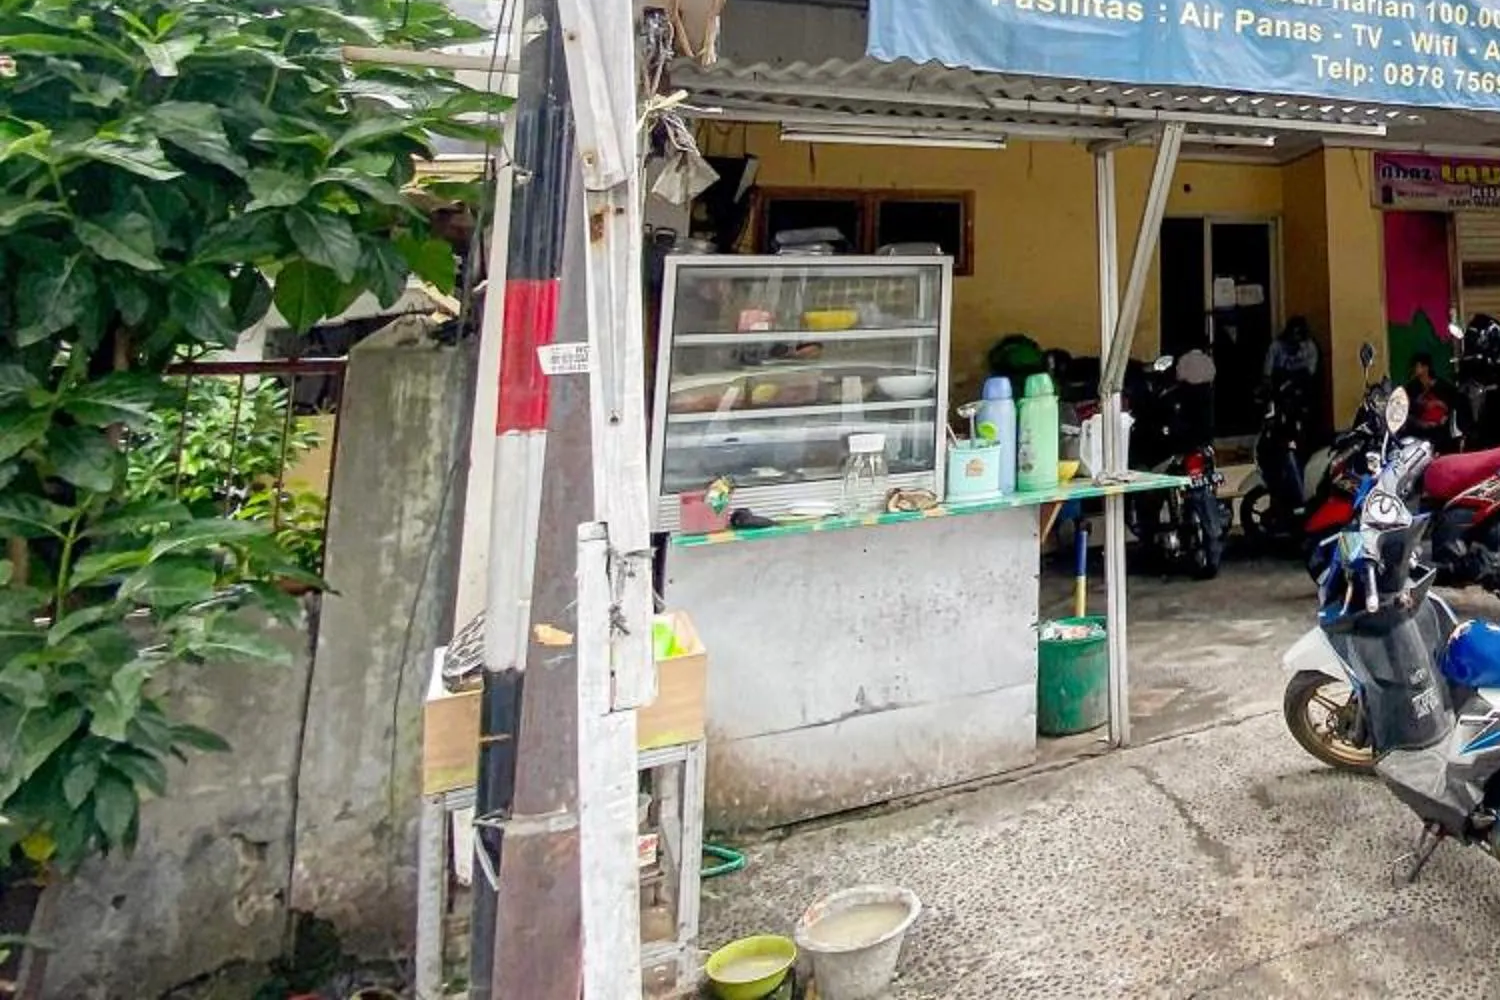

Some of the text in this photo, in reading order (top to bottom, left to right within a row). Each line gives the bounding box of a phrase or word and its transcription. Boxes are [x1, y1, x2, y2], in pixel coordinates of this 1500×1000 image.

[1179, 1, 1224, 32] Air
[1234, 9, 1323, 44] Panas
[1351, 24, 1383, 50] TV
[1312, 54, 1375, 85] Telp:
[1384, 61, 1445, 88] 0878
